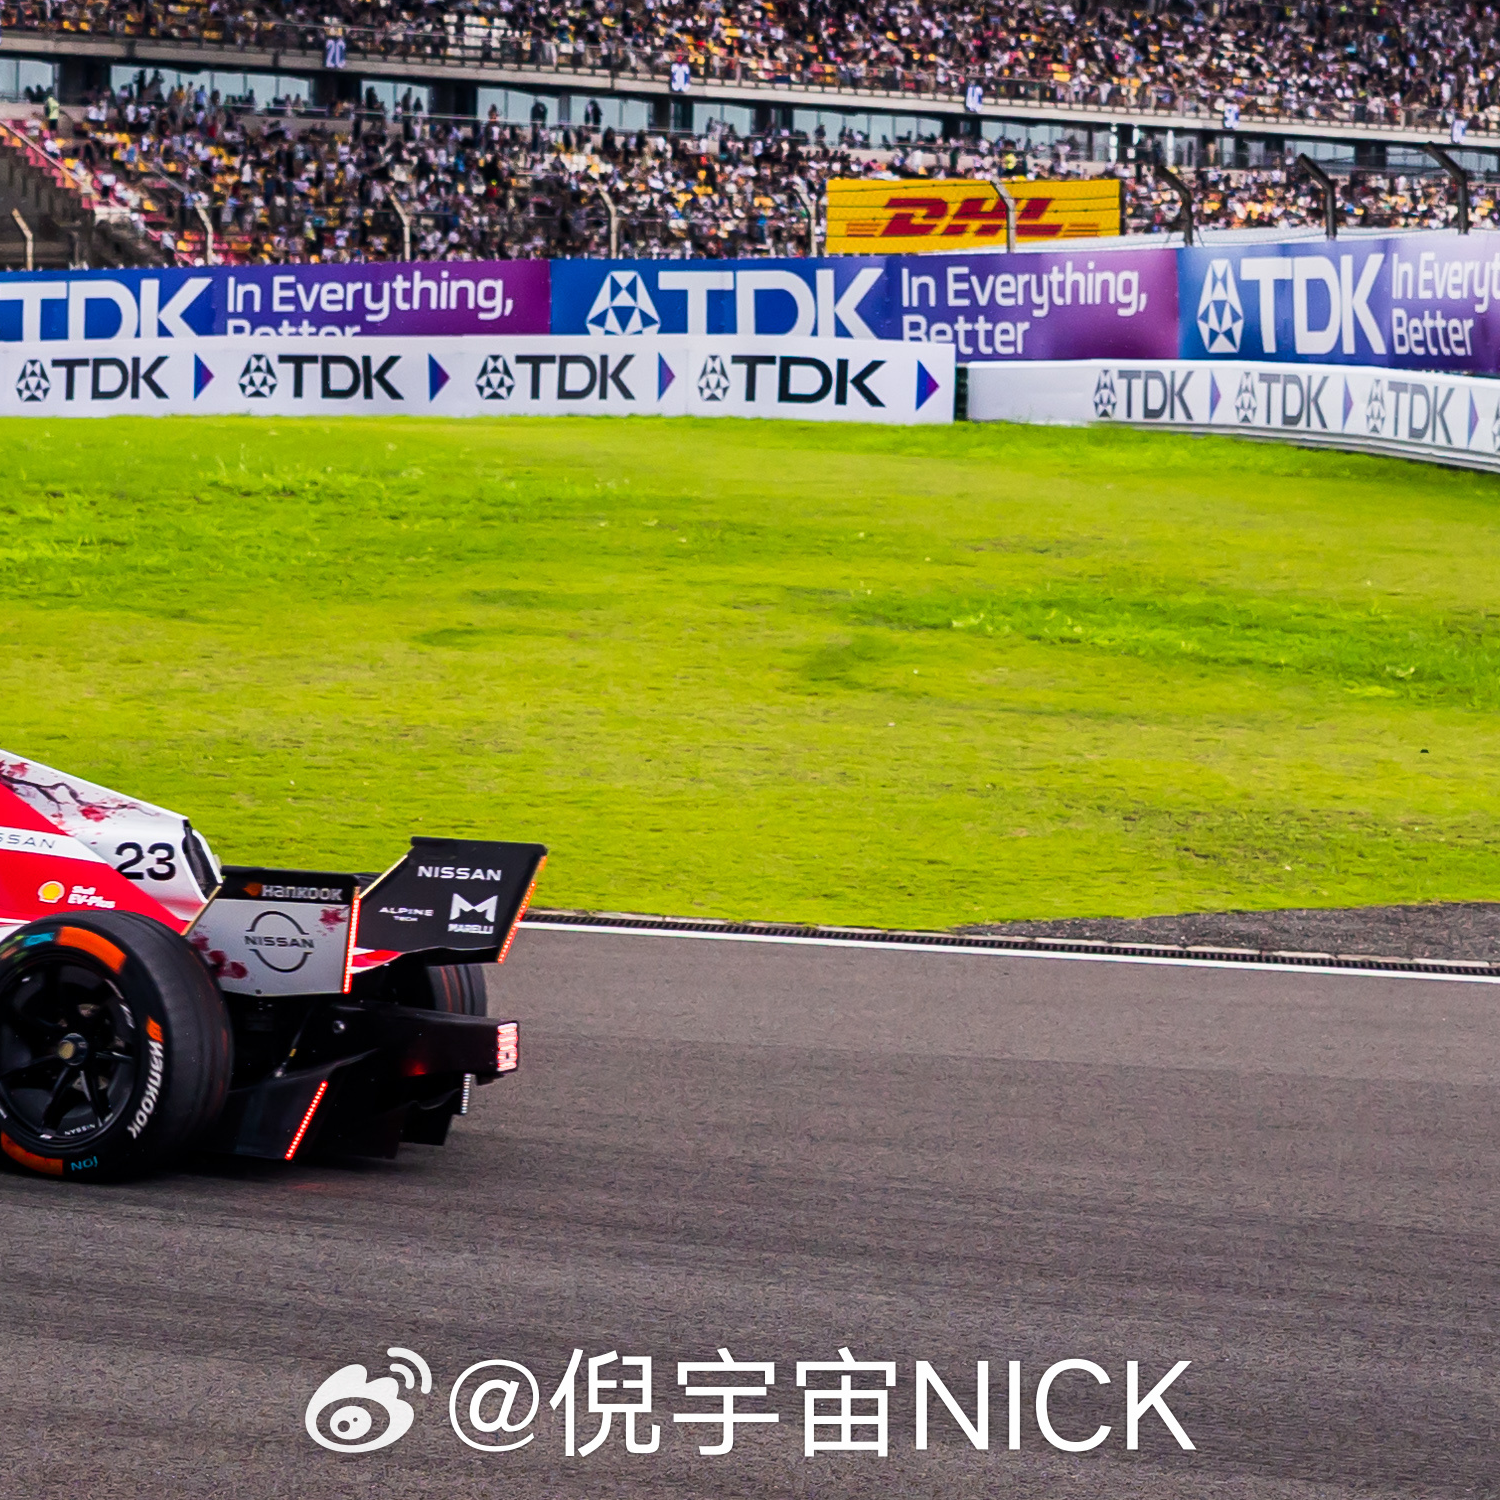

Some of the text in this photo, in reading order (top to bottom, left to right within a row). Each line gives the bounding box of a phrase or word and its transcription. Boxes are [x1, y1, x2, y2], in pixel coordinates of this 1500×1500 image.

[880, 198, 1063, 237] DHL
[227, 276, 261, 313] In
[272, 270, 513, 322] Everything,
[658, 261, 1147, 340] TDK In Everything,
[1240, 253, 1387, 355] TDK
[1392, 253, 1414, 299] In
[902, 315, 1030, 355] Better
[1392, 309, 1474, 357] Better
[51, 356, 170, 401] TDK
[278, 354, 404, 401] TDK
[514, 354, 636, 401] TDK
[731, 355, 888, 408] TDK
[1117, 370, 1195, 422] TDK
[1258, 373, 1331, 430] TDK
[1388, 380, 1455, 446] TDK
[115, 842, 176, 881] 23
[417, 866, 502, 881] NISSAN
[379, 907, 434, 917] ALPINE
[448, 924, 495, 934] MARELLI
[244, 935, 315, 949] NISSAN
